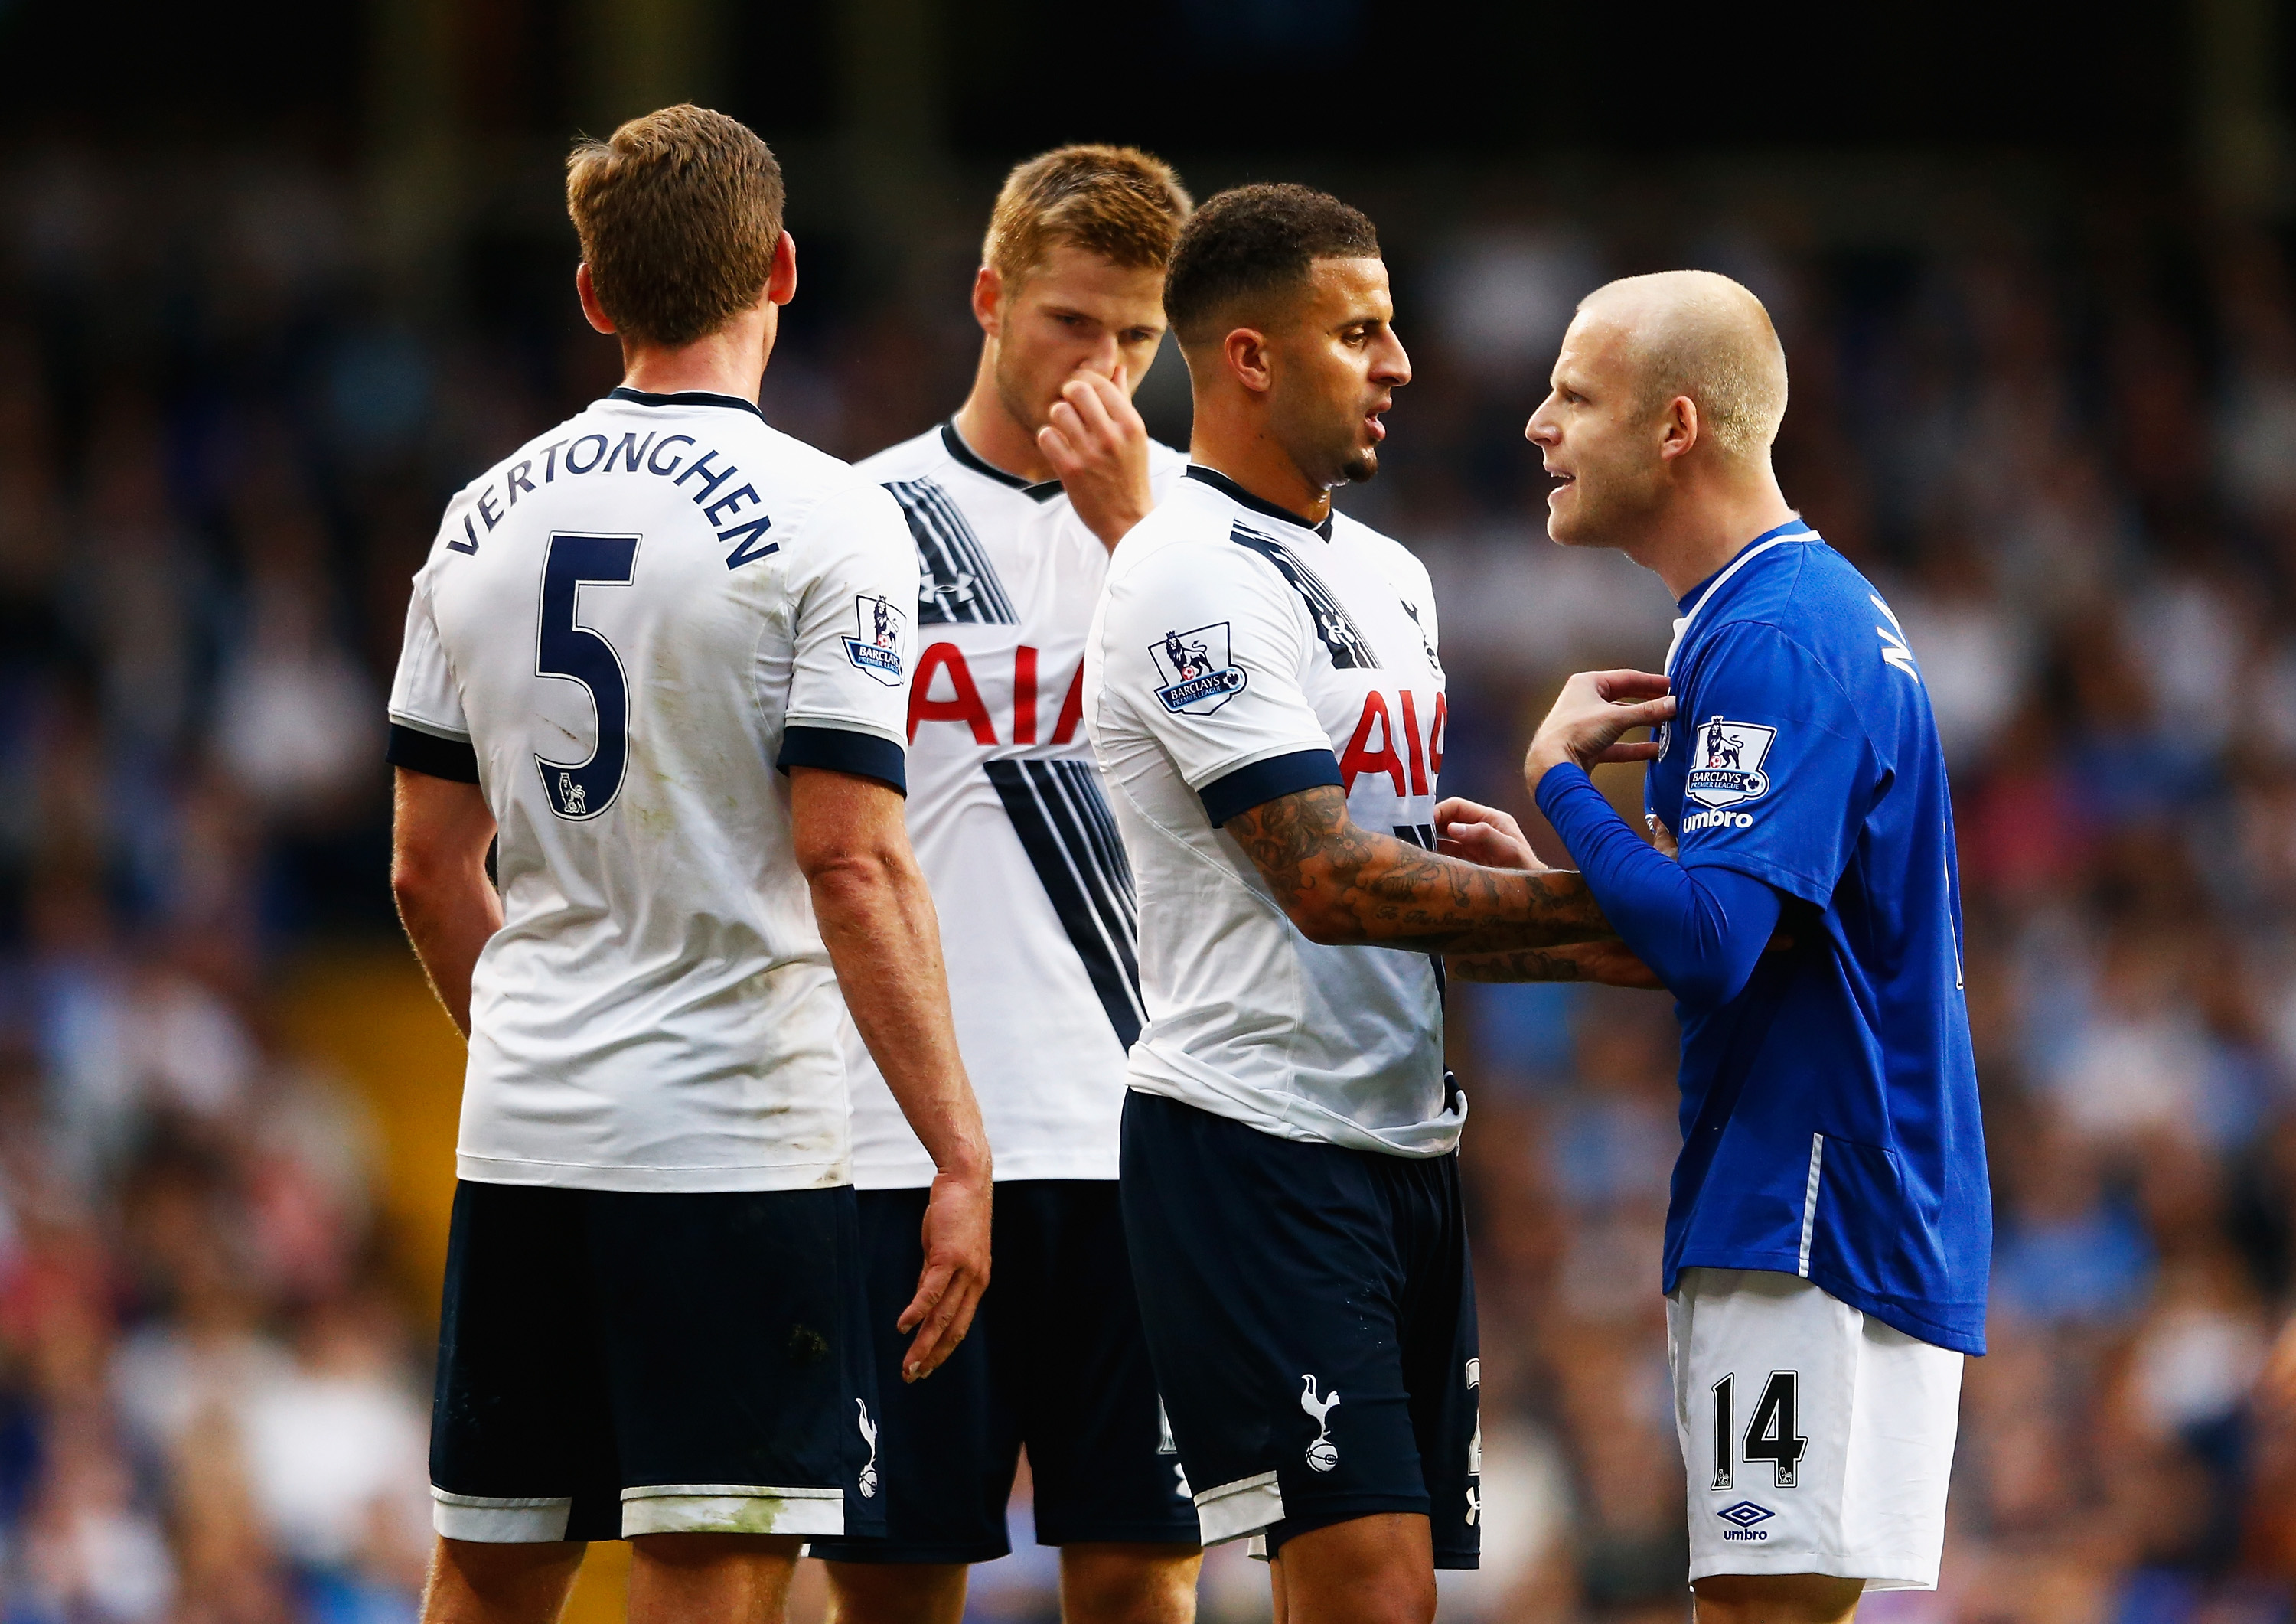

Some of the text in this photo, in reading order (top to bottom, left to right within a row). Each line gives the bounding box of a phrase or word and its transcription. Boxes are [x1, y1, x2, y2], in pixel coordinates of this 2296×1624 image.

[447, 430, 781, 571] VERTONGHEN
[534, 530, 643, 821] 5
[1170, 675, 1221, 700] BARCLAYS
[1172, 685, 1223, 706] PREMIER LEAGUE
[1692, 771, 1742, 784] BARCLAYS
[1714, 781, 1740, 790] LEAGUE
[1683, 809, 1753, 833] umbro
[1711, 1370, 1808, 1491] 14
[1724, 1528, 1768, 1541] umbro
